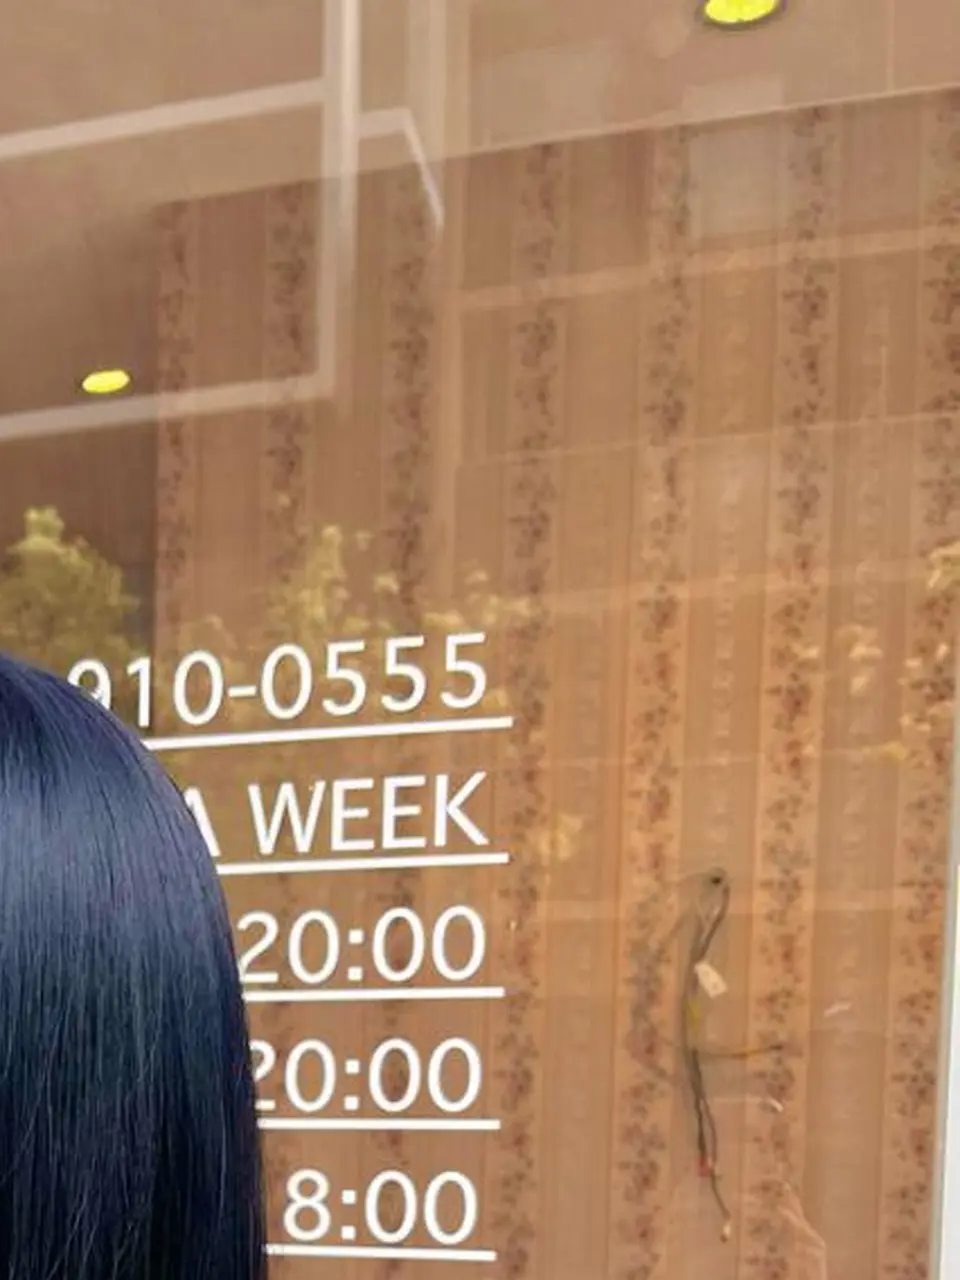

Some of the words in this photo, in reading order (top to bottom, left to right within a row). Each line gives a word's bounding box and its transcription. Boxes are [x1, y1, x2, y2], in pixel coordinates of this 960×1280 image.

[248, 771, 489, 855] WEEK
[237, 905, 486, 984] 20:00
[250, 1038, 482, 1113] 20:00
